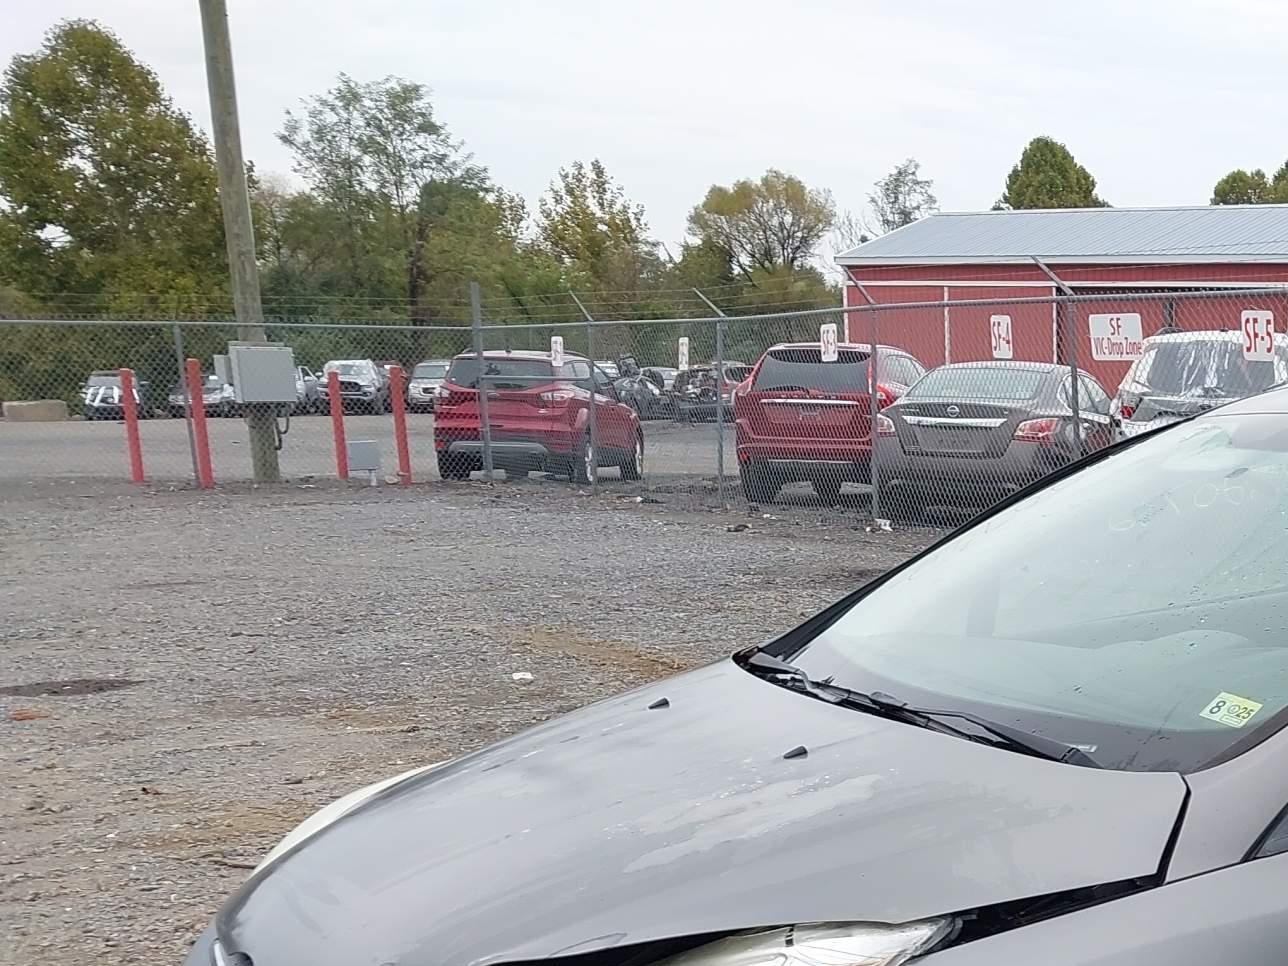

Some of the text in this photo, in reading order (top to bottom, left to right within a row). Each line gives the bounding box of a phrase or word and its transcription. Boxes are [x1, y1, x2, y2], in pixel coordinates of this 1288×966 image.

[991, 320, 1011, 352] SF-4
[1109, 317, 1122, 336] SF
[1244, 317, 1273, 353] SF-5
[1125, 337, 1143, 356] Zone
[1235, 707, 1255, 719] 25
